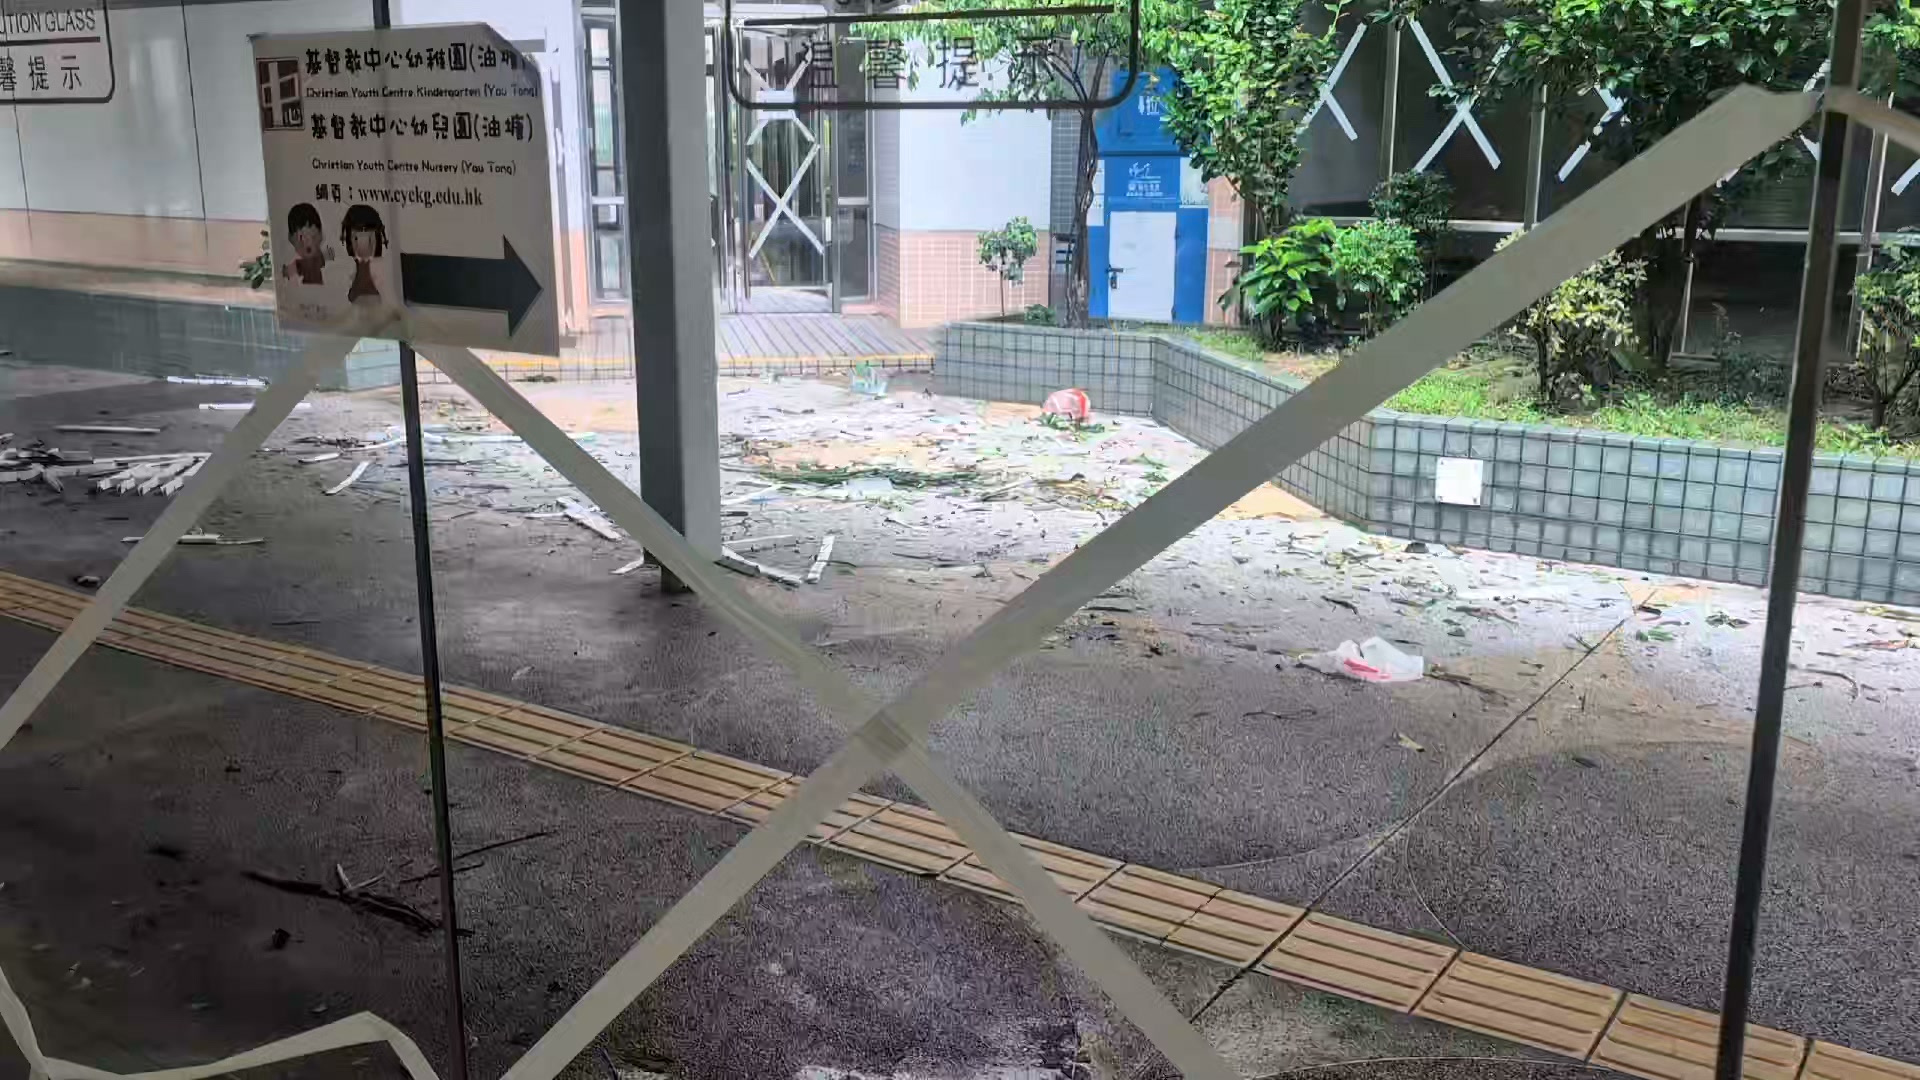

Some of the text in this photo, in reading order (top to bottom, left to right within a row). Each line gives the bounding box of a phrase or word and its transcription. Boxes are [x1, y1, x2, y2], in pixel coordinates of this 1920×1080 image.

[45, 8, 96, 32] GLASS
[306, 87, 348, 98] Christian
[351, 87, 379, 98] Youth
[382, 86, 414, 98] Centre
[417, 85, 481, 98] Kindergarten
[312, 157, 355, 171] Christian
[357, 158, 385, 172] Youth
[388, 160, 419, 173] Centre
[421, 160, 458, 175] Nursery
[358, 186, 483, 208] www.cyckg.edu.hk
